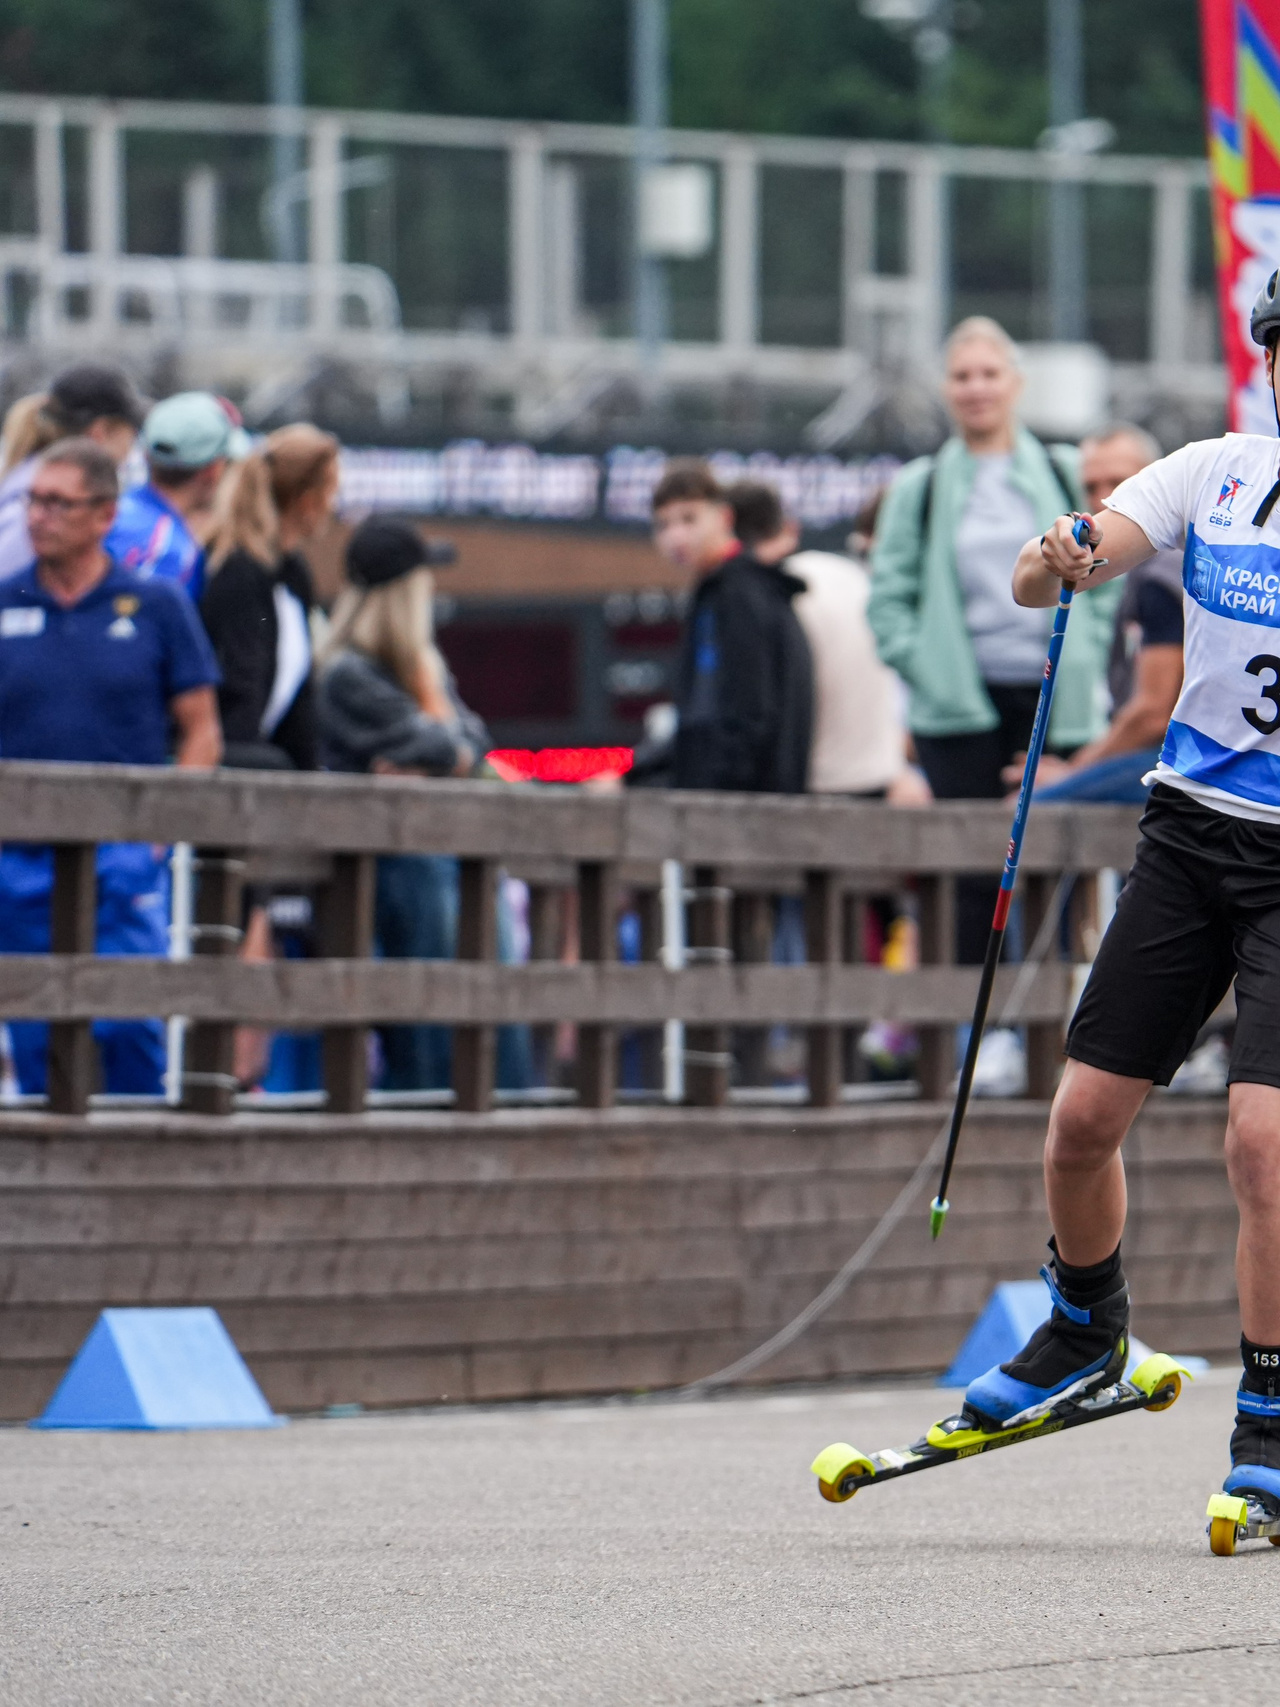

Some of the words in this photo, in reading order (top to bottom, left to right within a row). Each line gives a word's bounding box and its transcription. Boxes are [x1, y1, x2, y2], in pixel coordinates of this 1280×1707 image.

[1209, 515, 1232, 527] СБР
[1219, 588, 1277, 616] КРАЙ
[1252, 1351, 1280, 1367] 153
